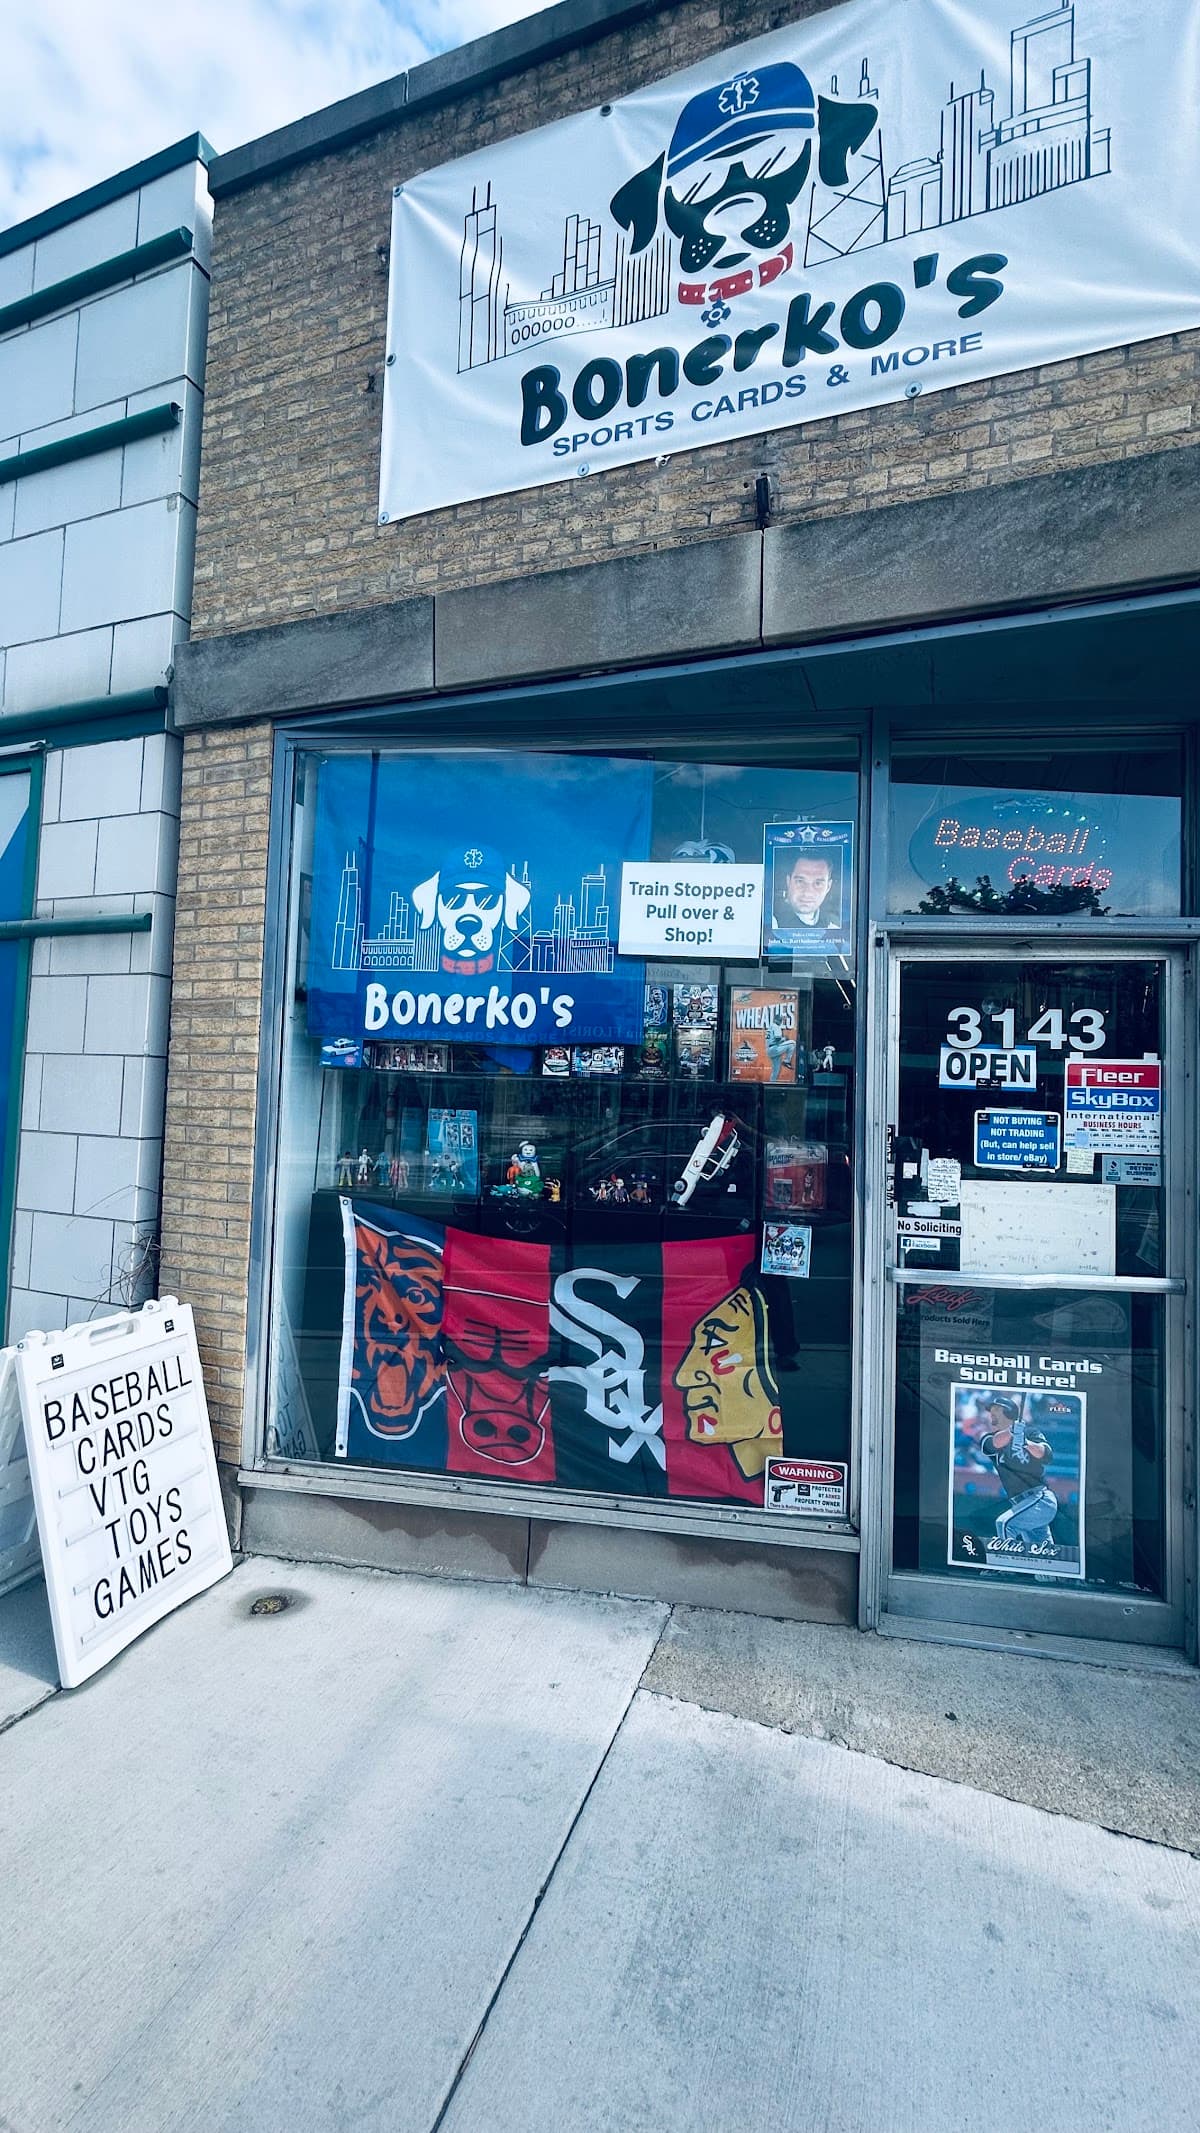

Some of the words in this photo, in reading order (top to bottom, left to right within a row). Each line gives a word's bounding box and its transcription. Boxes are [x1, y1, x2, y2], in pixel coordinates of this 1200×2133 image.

[521, 253, 1008, 446] Bonerko's
[552, 410, 674, 457] SPORTS
[690, 374, 807, 423] CARDS
[825, 363, 851, 387] &
[870, 331, 983, 376] MORE
[934, 818, 1090, 854] Baseball
[1007, 856, 1113, 890] Cards
[629, 881, 669, 896] Train
[674, 882, 755, 900] Stopped?
[646, 904, 677, 919] Pull
[681, 908, 719, 920] over
[723, 906, 735, 920] &
[665, 927, 713, 945] Shop!
[364, 982, 574, 1031] Bonerko's
[946, 1006, 1107, 1053] 3143
[945, 1051, 1031, 1083] OPEN
[1081, 1067, 1145, 1085] Fleer
[1071, 1088, 1154, 1108] SkyBox
[993, 1116, 1009, 1125] NOT
[1012, 1117, 1042, 1126] BUYING
[1083, 1121, 1116, 1129] BUSINESS
[1118, 1121, 1142, 1129] HOURS
[990, 1128, 1007, 1136] NOT
[1008, 1129, 1045, 1138] TRADING
[980, 1139, 1000, 1149] (But,
[1020, 1141, 1037, 1151] help
[1039, 1142, 1055, 1150] sell
[987, 1152, 995, 1160] in
[1023, 1154, 1048, 1164] eBay)
[897, 1220, 911, 1230] No
[914, 1221, 962, 1236] Soliciting
[906, 1285, 983, 1311] Leaf
[952, 1316, 970, 1325] Sold
[971, 1318, 991, 1326] Here
[934, 1349, 1030, 1369] Baseball
[1039, 1356, 1103, 1374] Cards
[960, 1367, 1008, 1384] Sold
[1016, 1371, 1076, 1388] Here!
[44, 1355, 193, 1442] BASEBALL
[77, 1403, 173, 1475] CARDS
[778, 1466, 834, 1480] WARNING
[89, 1459, 150, 1517] VTG
[812, 1485, 841, 1493] PROTECTED
[105, 1487, 182, 1559] TOYS
[987, 1537, 1025, 1553] White
[1028, 1540, 1058, 1556] Sox
[93, 1528, 192, 1619] GAMES
